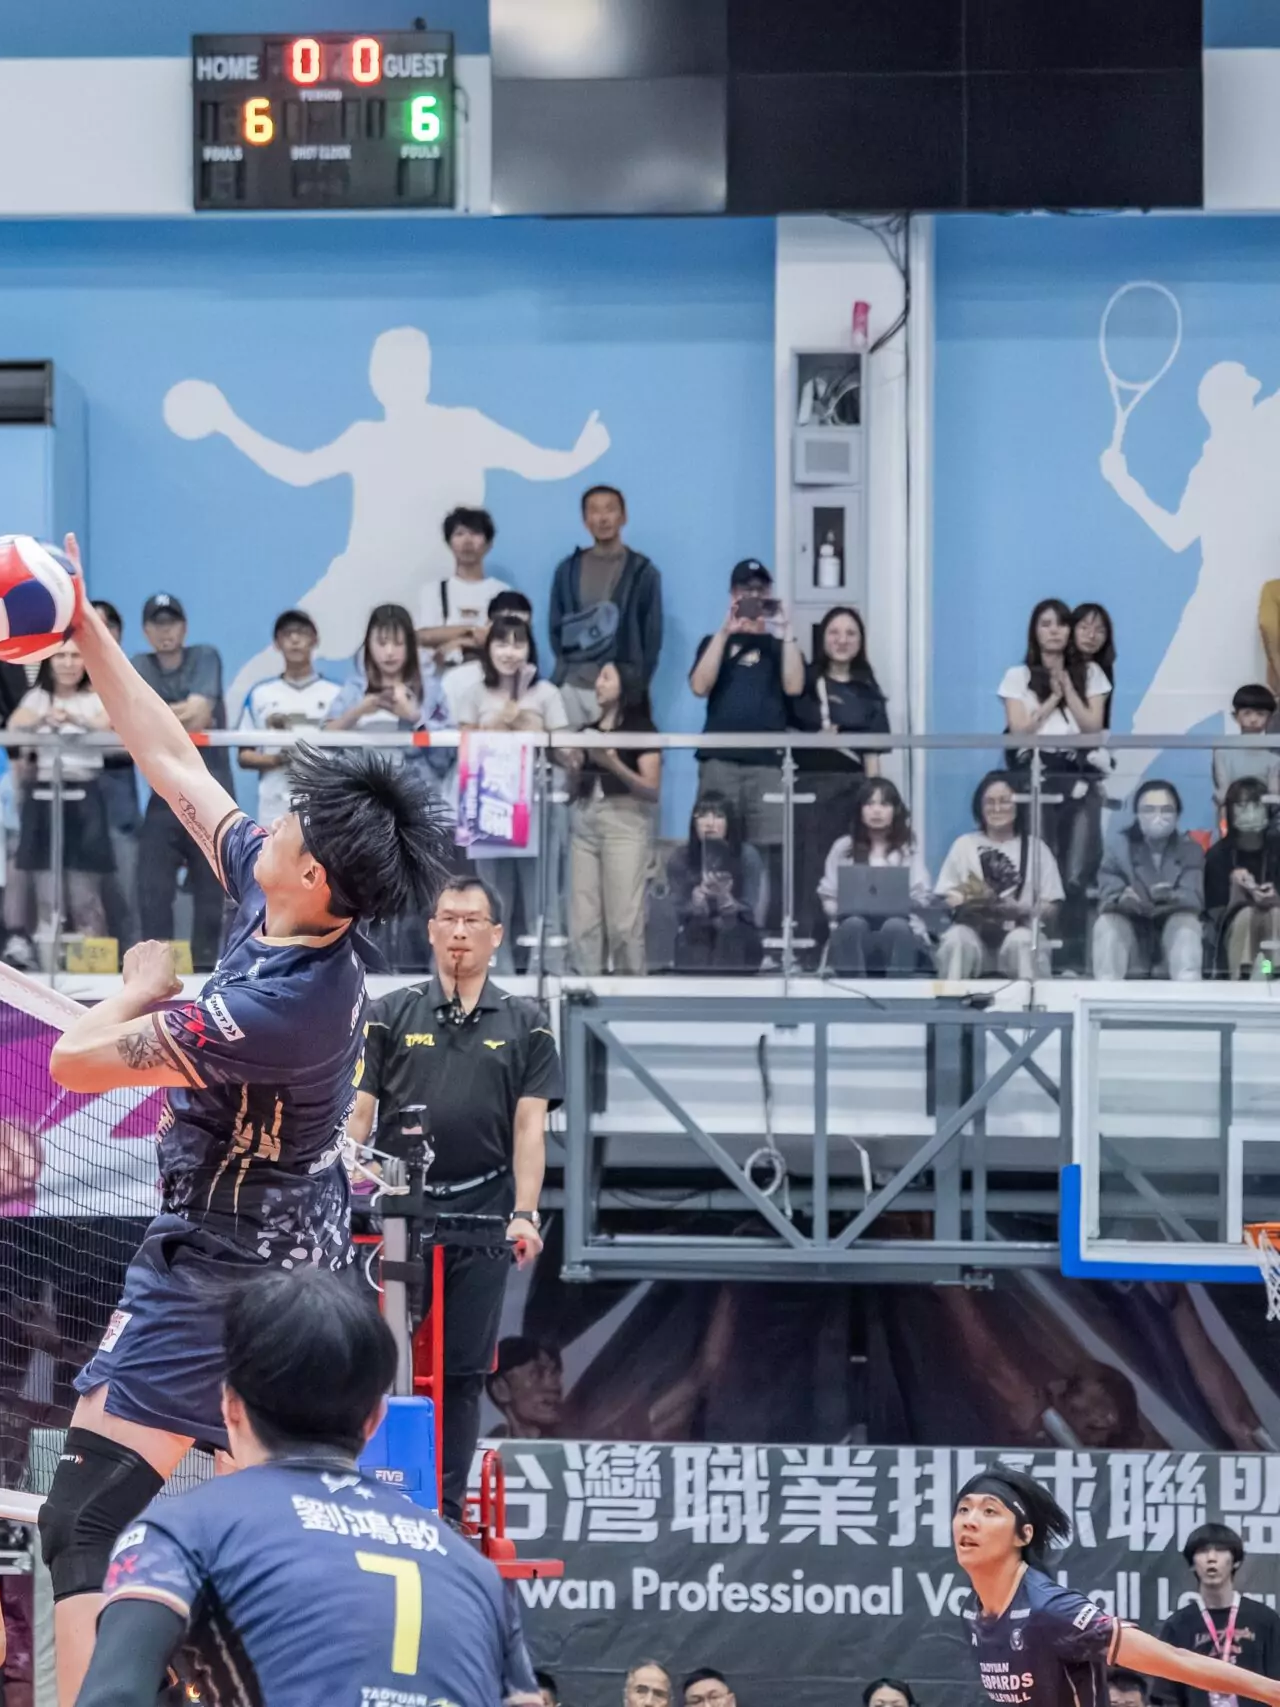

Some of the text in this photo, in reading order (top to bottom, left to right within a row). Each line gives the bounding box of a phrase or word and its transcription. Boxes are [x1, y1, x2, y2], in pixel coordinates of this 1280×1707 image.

[196, 55, 259, 80] HOME
[383, 53, 448, 78] GUEST
[244, 97, 273, 143] 6
[411, 95, 440, 141] 6
[375, 1470, 404, 1482] FIVB
[291, 1494, 448, 1556] 劉鴻敏
[518, 1578, 616, 1610] wan
[632, 1563, 903, 1616] Professional
[354, 1550, 422, 1676] 7
[361, 1686, 428, 1707] TAOYUAN
[981, 1672, 1034, 1690] EOPARDS
